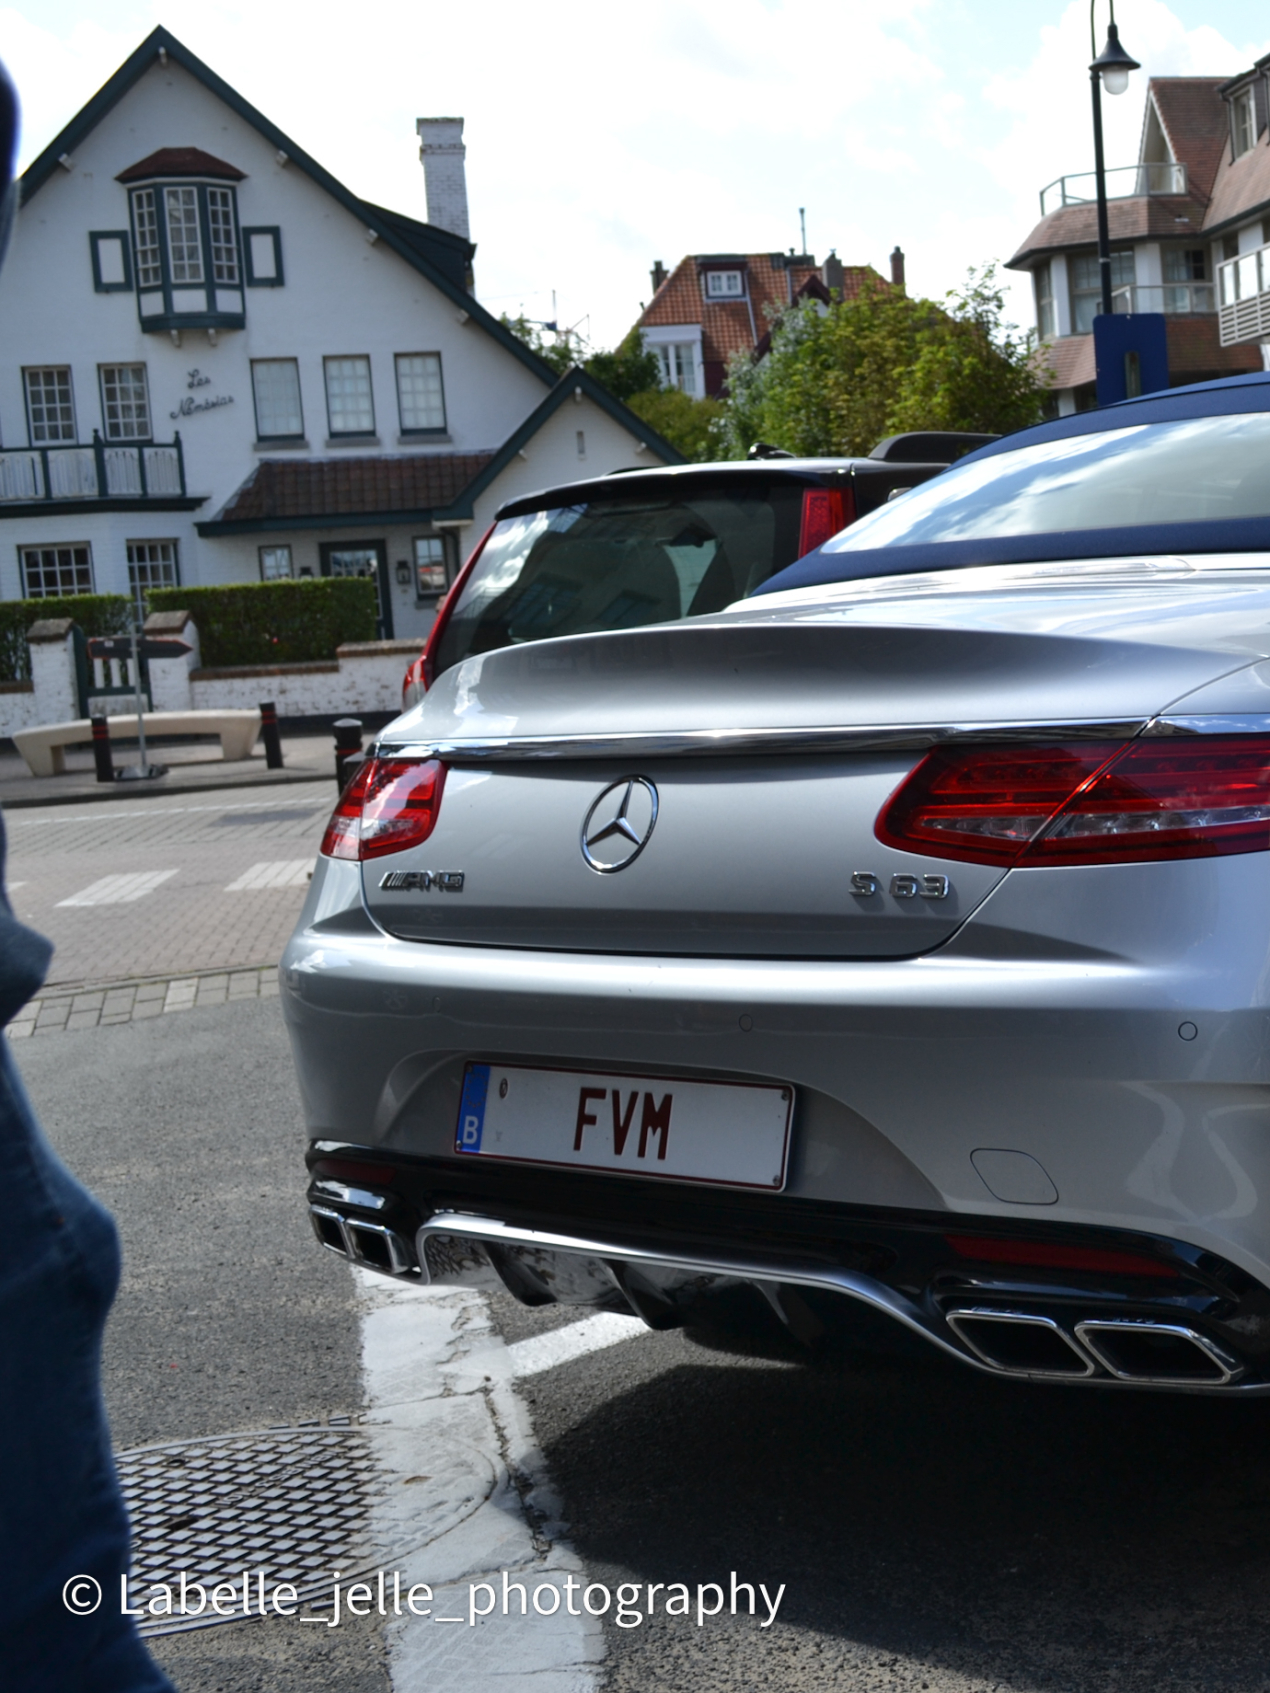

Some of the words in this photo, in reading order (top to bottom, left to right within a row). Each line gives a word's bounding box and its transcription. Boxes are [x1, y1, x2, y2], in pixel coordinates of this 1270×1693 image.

[848, 871, 876, 896] S
[889, 873, 949, 899] 63
[462, 1115, 479, 1145] B
[573, 1086, 673, 1161] FVM
